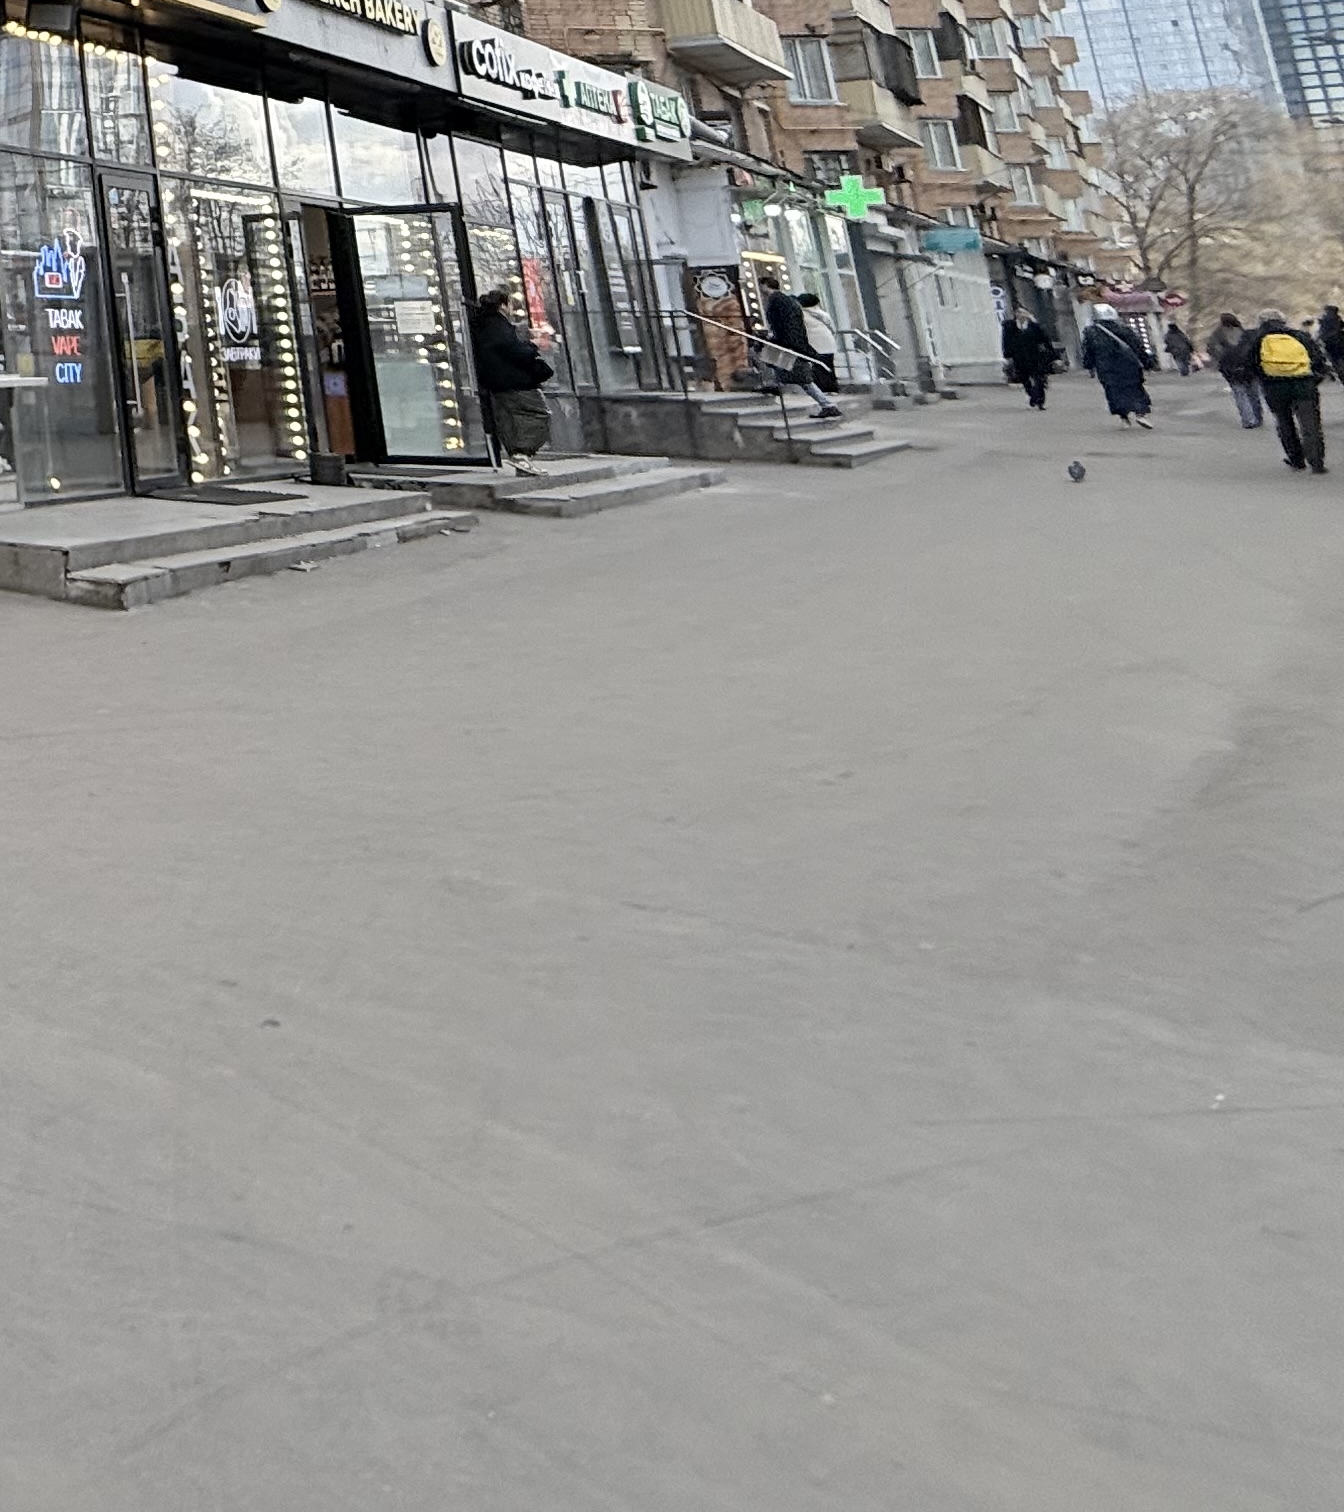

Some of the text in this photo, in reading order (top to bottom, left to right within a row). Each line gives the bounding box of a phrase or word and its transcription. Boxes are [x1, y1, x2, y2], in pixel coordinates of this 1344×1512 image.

[44, 308, 85, 329] TABAK
[51, 336, 82, 356] VAPE
[55, 362, 83, 383] CITY
